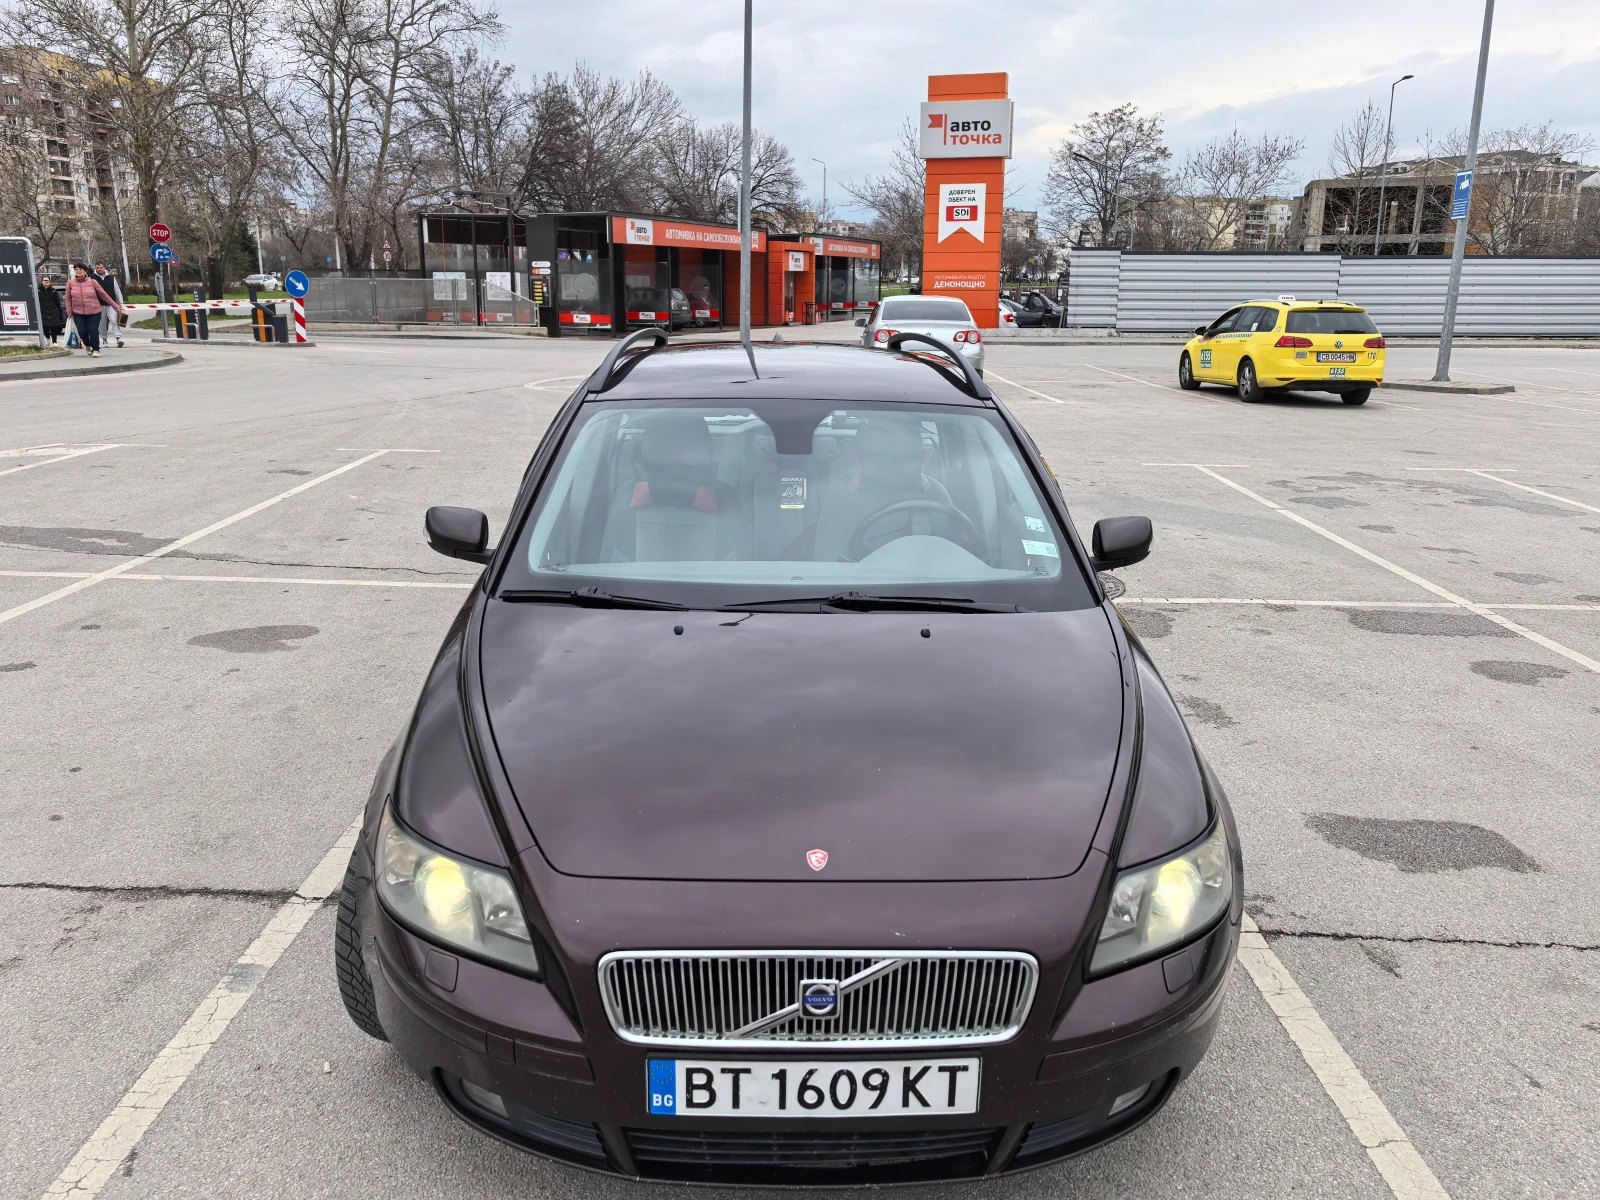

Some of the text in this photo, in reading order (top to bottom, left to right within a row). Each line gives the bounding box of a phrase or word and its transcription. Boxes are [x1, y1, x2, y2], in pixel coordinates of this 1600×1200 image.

[950, 120, 991, 132] авто
[950, 133, 1002, 145] точка
[954, 208, 969, 217] SDI
[152, 229, 168, 237] STOP
[636, 226, 648, 234] авто
[665, 228, 695, 240] АВТОМИВКА
[696, 231, 703, 241] НА
[934, 281, 986, 289] ДЕНОНОЩНО
[685, 1065, 969, 1110] BT 1609 KT
[653, 1094, 673, 1107] BG
